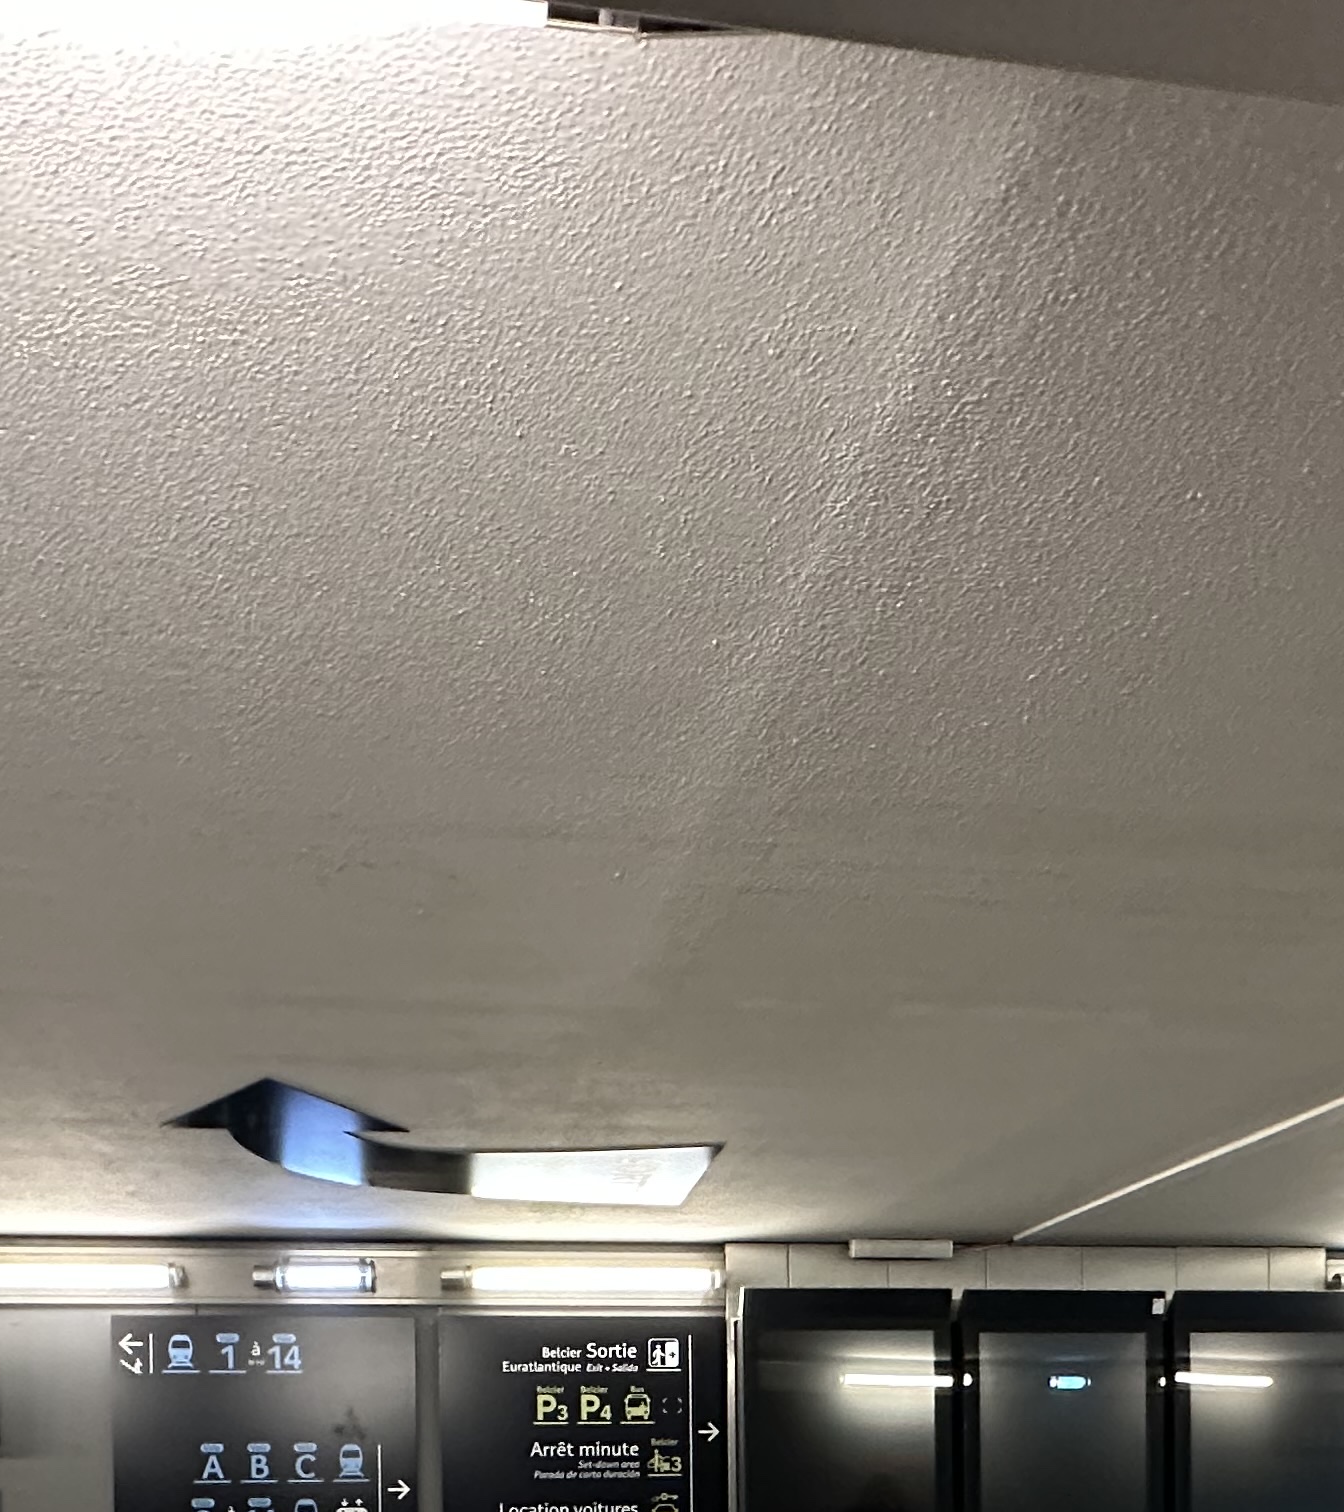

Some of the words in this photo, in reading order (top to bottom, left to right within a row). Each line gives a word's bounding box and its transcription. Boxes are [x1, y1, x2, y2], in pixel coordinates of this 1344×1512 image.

[221, 1345, 234, 1369] 1
[267, 1345, 301, 1369] 14
[542, 1346, 583, 1359] Belcier
[586, 1342, 637, 1359] Sortie
[502, 1361, 582, 1375] Euratlantique
[536, 1393, 569, 1421] P3
[580, 1393, 613, 1421] P4
[530, 1441, 575, 1457] Arrêt
[579, 1440, 640, 1457] minute
[202, 1455, 225, 1479] A
[250, 1455, 270, 1479] B
[295, 1454, 316, 1479] C
